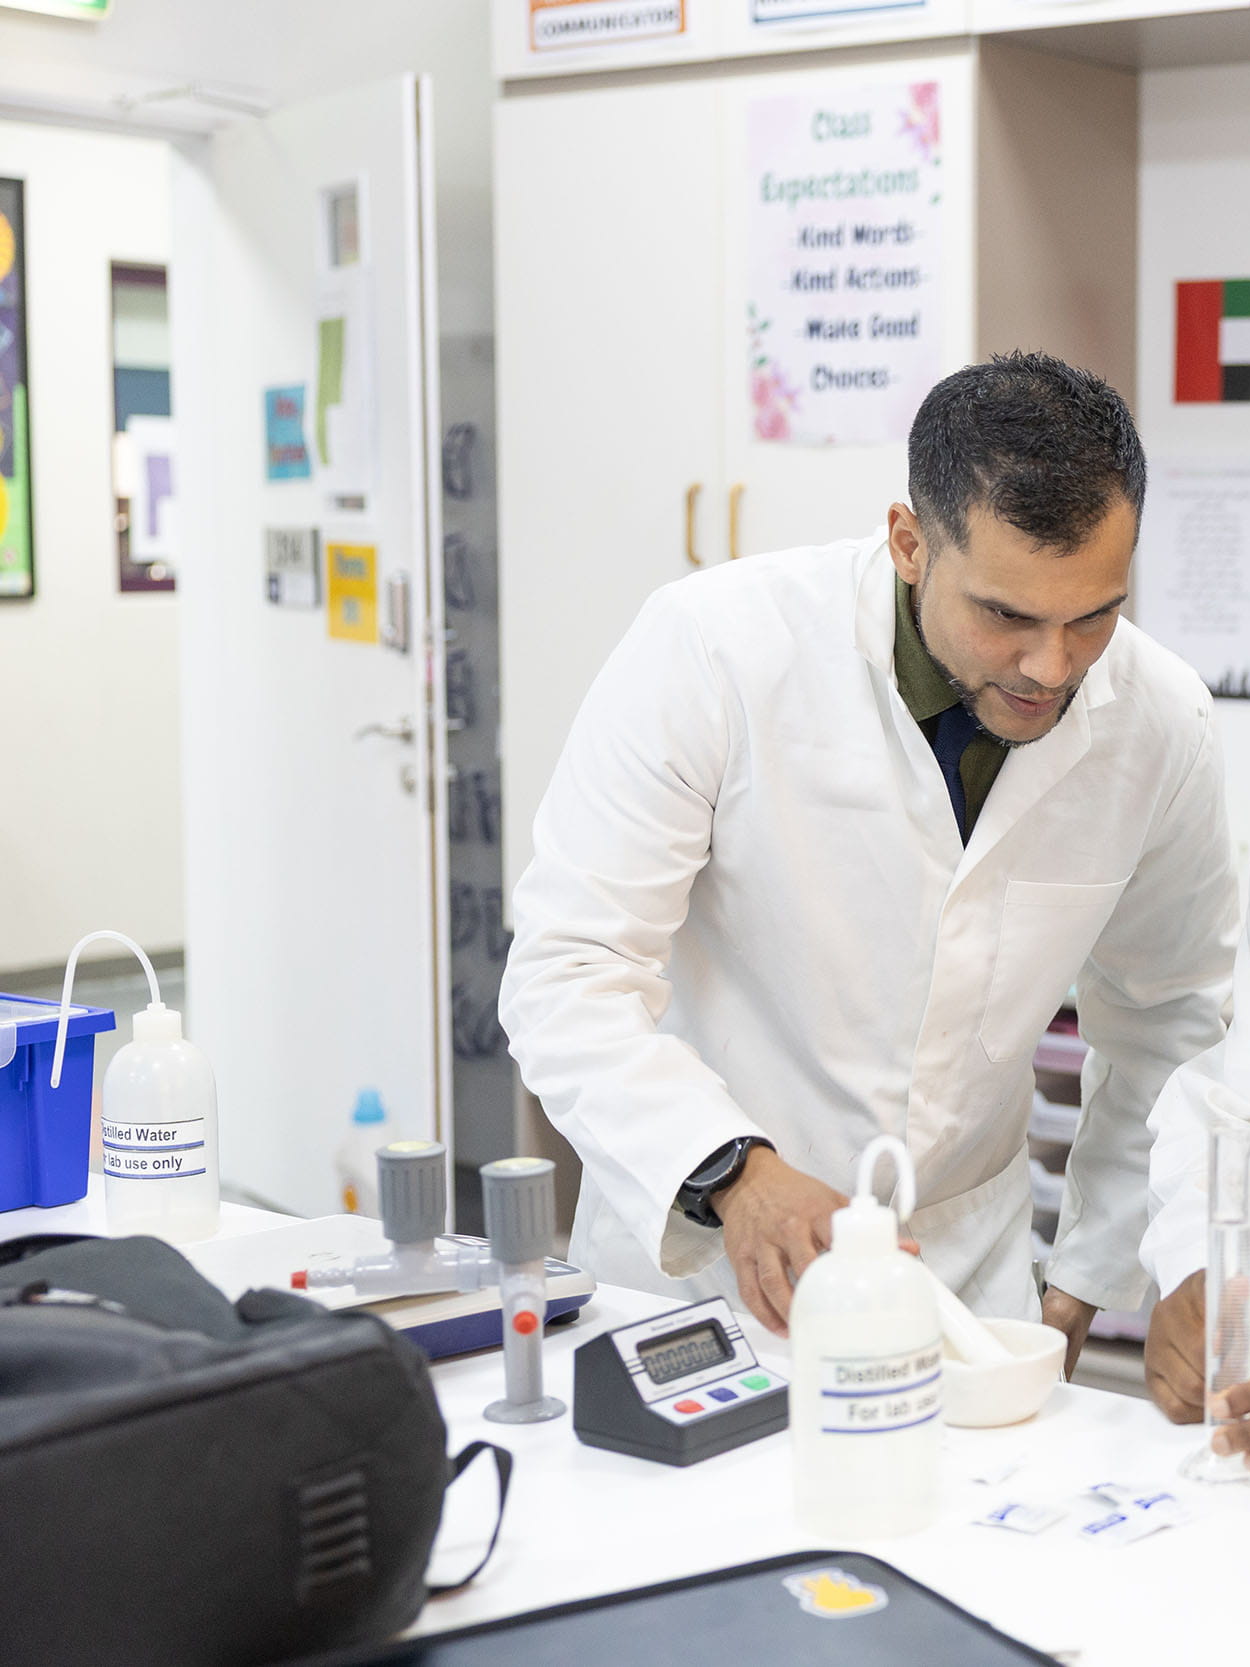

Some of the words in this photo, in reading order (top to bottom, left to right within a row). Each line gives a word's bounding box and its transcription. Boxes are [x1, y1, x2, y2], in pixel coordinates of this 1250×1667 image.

[811, 109, 871, 141] Class
[760, 167, 919, 211] Expectations
[870, 312, 919, 338] Good
[102, 1126, 131, 1140] stilled
[135, 1128, 177, 1141] Water
[108, 1153, 121, 1168] lab
[125, 1159, 148, 1170] use
[152, 1156, 182, 1171] only
[835, 1360, 910, 1385] Distilled
[848, 1402, 879, 1421] For
[885, 1400, 911, 1418] lab
